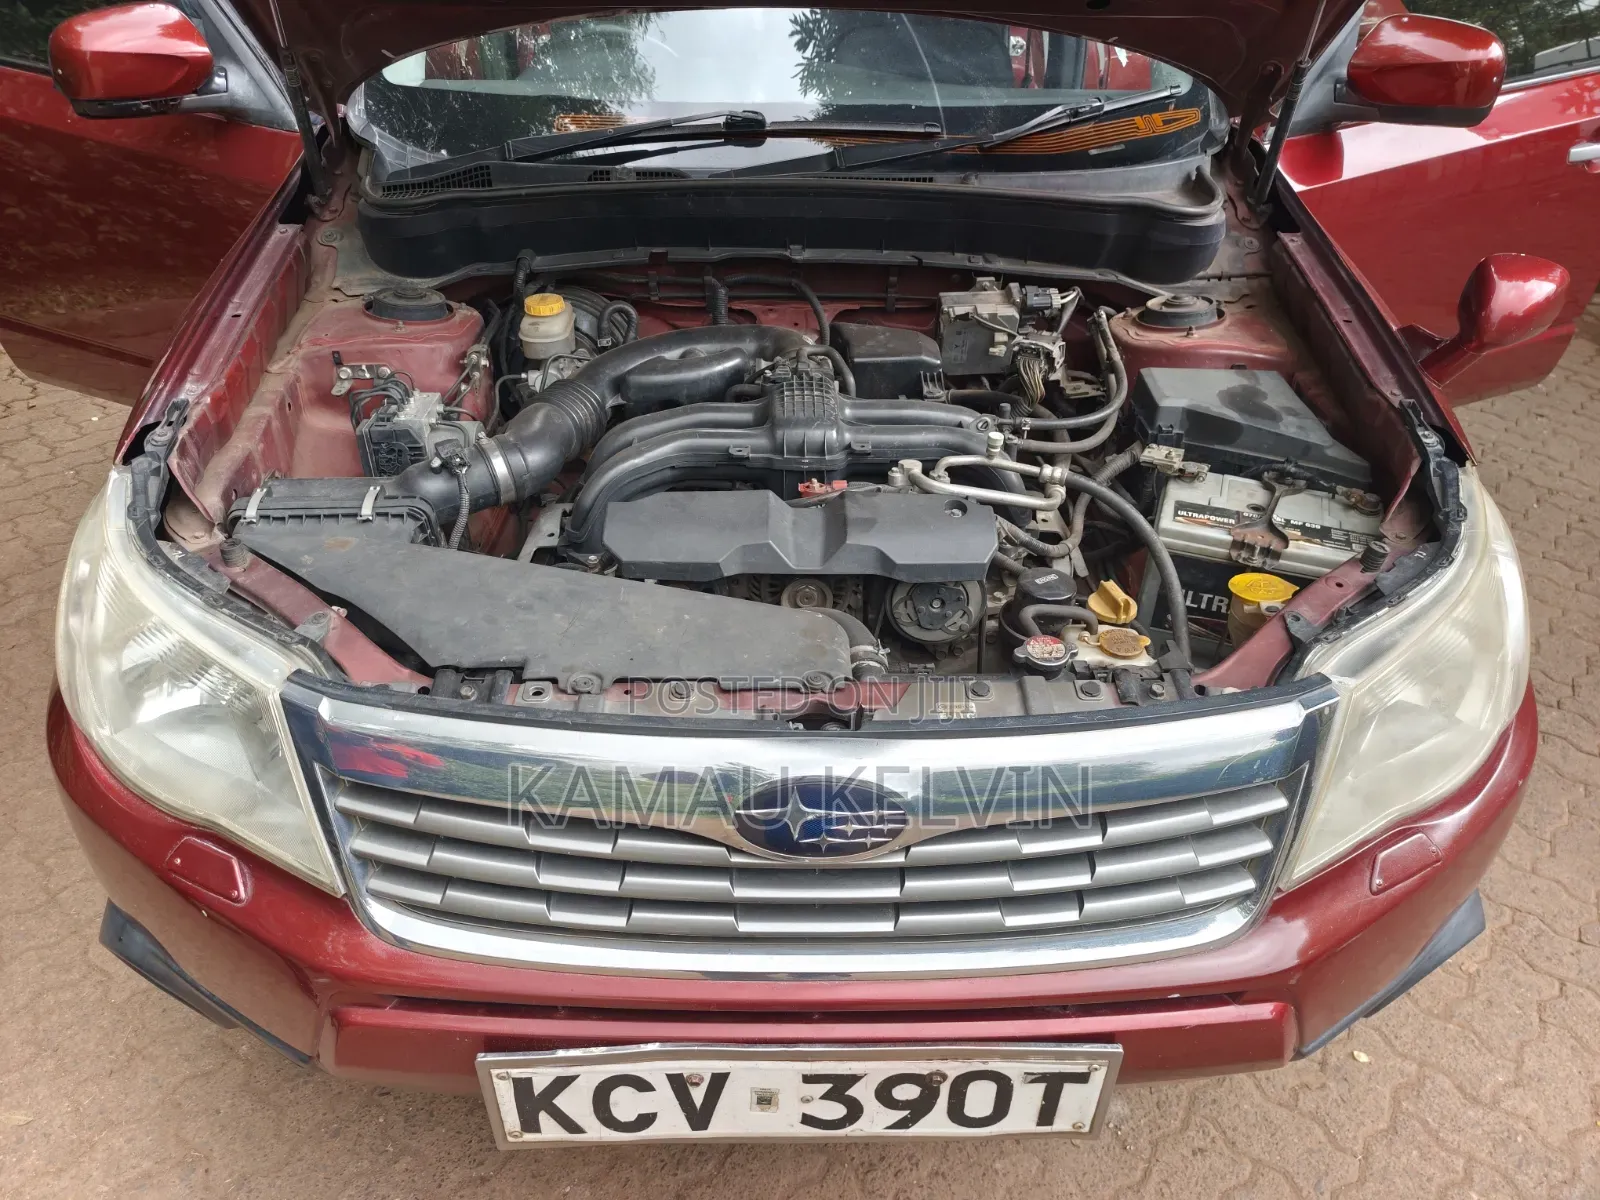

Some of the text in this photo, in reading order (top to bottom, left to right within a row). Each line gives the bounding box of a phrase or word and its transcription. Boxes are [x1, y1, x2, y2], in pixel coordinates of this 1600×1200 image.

[1177, 510, 1236, 524] ULTRAPOWER
[1290, 519, 1304, 527] MF
[1304, 521, 1322, 531] 639
[511, 1069, 1090, 1133] KCV 390T
